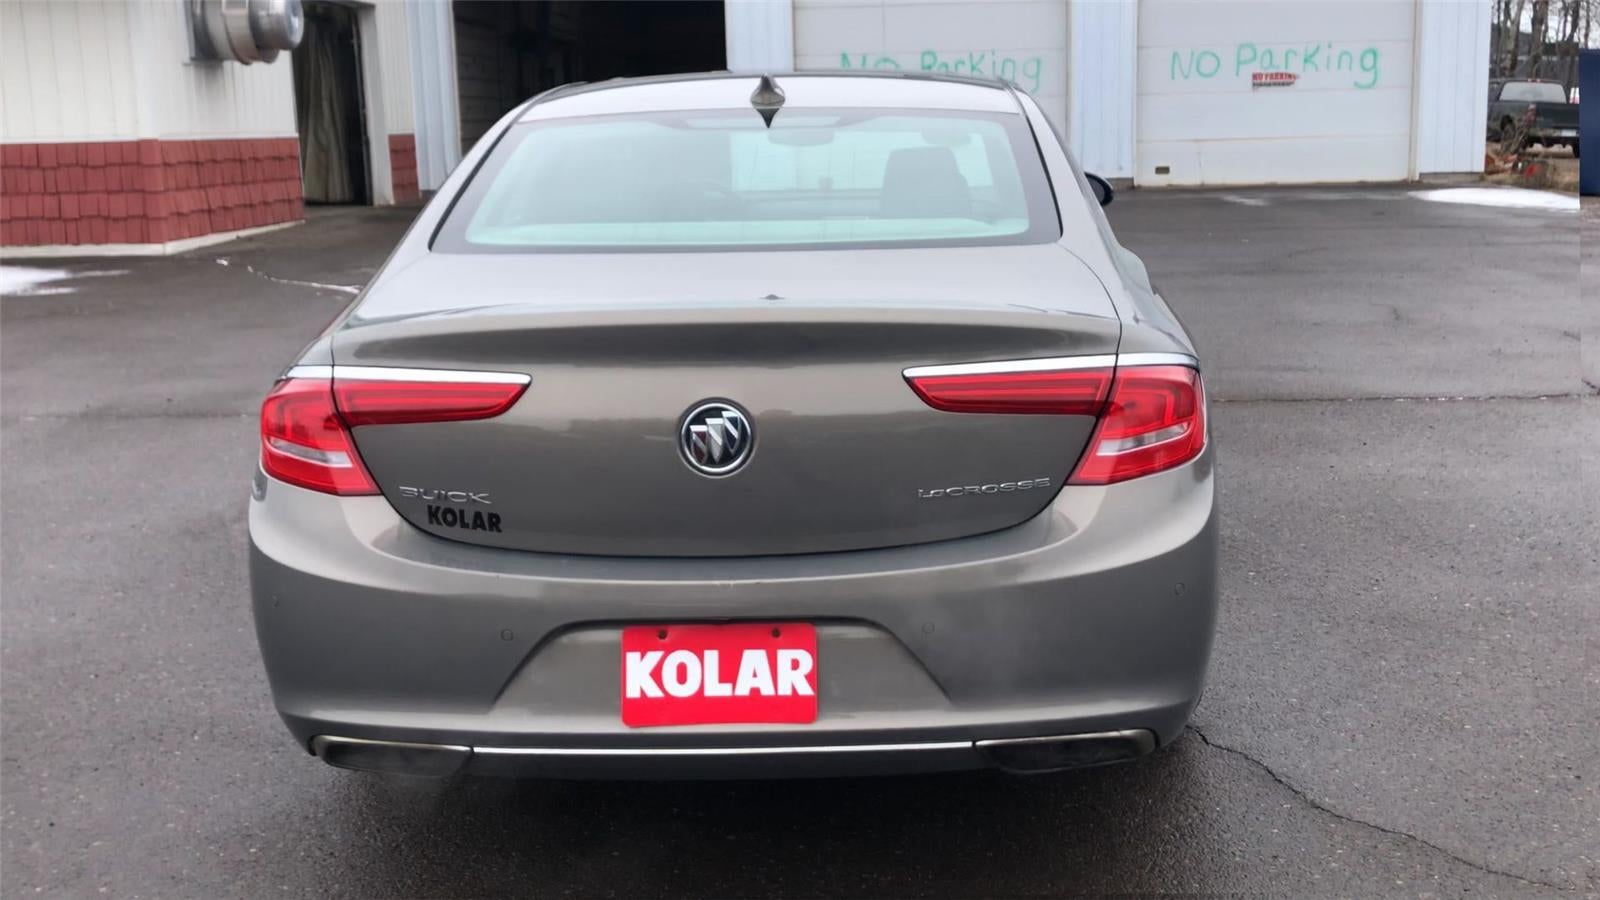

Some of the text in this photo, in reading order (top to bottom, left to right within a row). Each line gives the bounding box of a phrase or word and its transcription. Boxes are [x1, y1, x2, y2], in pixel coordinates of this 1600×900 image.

[1170, 43, 1380, 89] NO Parking
[398, 485, 492, 504] BUICK
[427, 504, 503, 533] KOLAR
[625, 649, 815, 698] KOLAR
